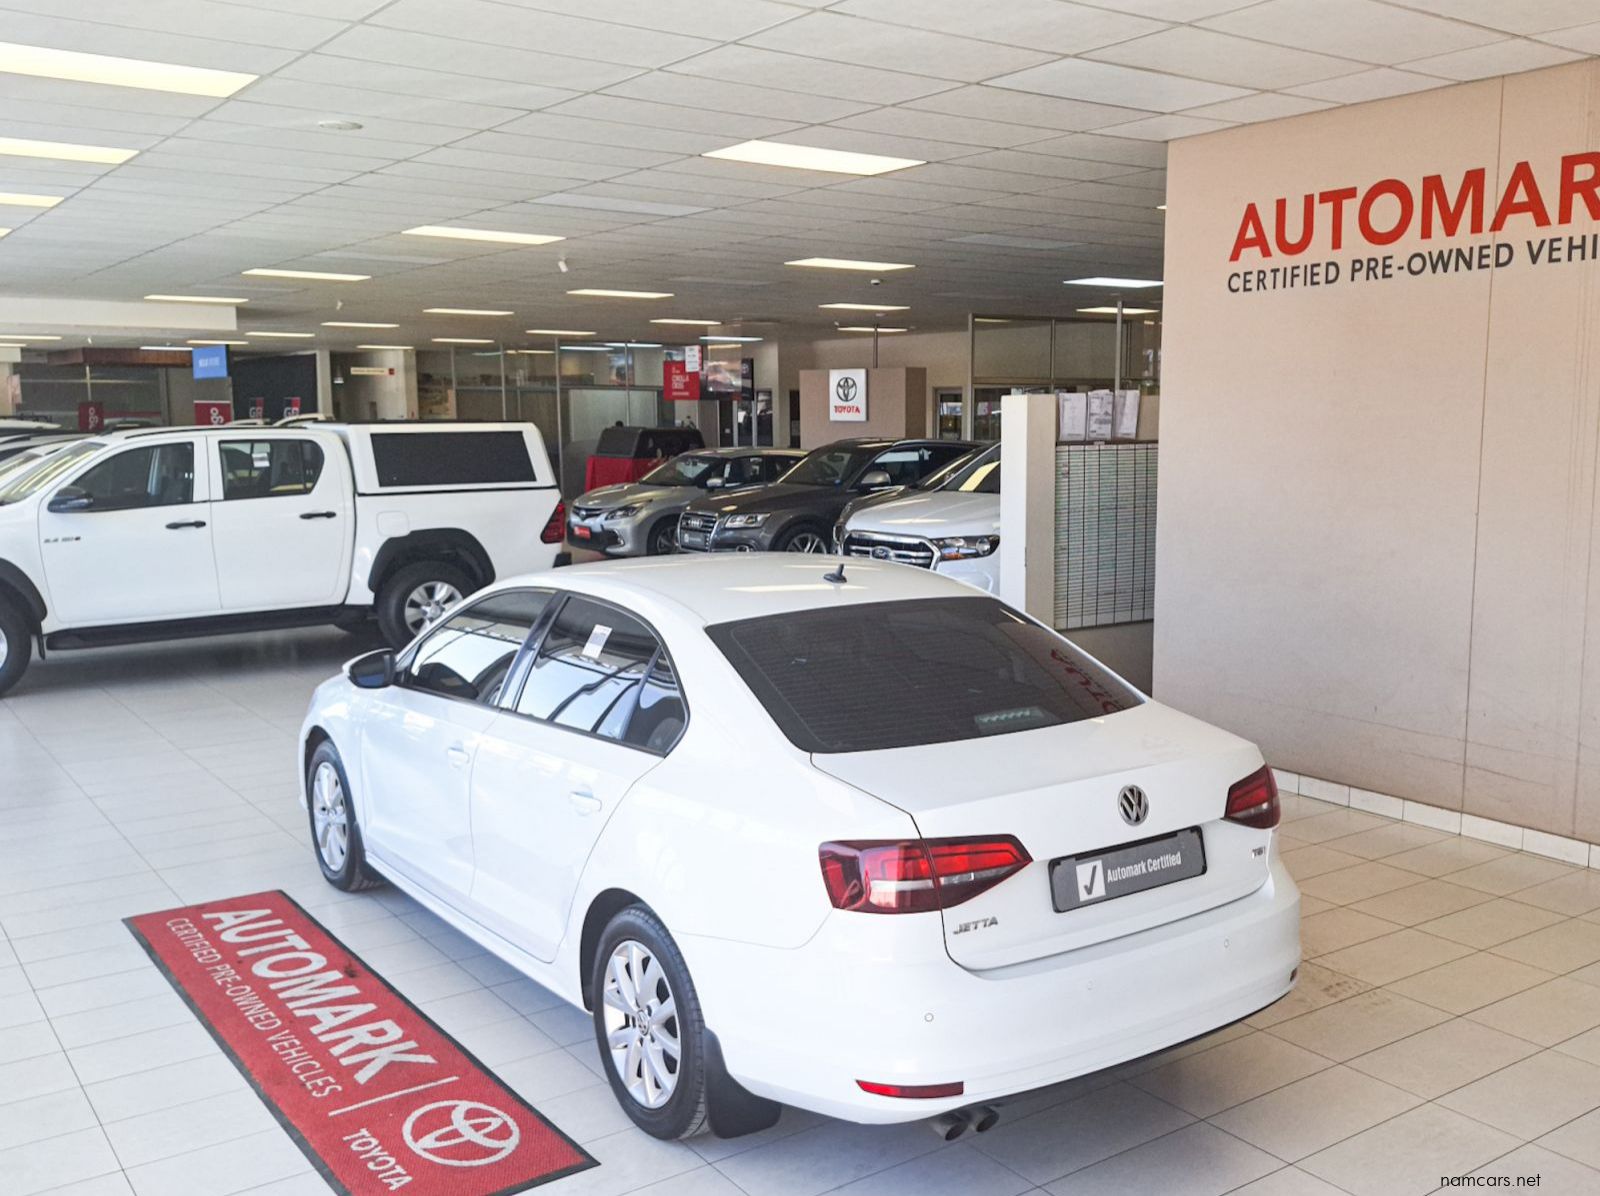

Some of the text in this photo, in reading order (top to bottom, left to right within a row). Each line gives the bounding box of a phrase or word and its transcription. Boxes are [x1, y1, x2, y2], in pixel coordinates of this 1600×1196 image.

[1229, 151, 1600, 262] AUTOMAR
[1227, 234, 1600, 294] CERTIFIED PRE-OWNED VEHI
[834, 405, 861, 415] TOYOTA
[1106, 851, 1182, 883] Automark Certified
[953, 916, 999, 935] JETTA
[166, 917, 343, 1098] CERTIFIED PRE-OWNED VEHICLES
[202, 908, 438, 1086] AUTOMARK
[342, 1127, 414, 1192] TOYOTA
